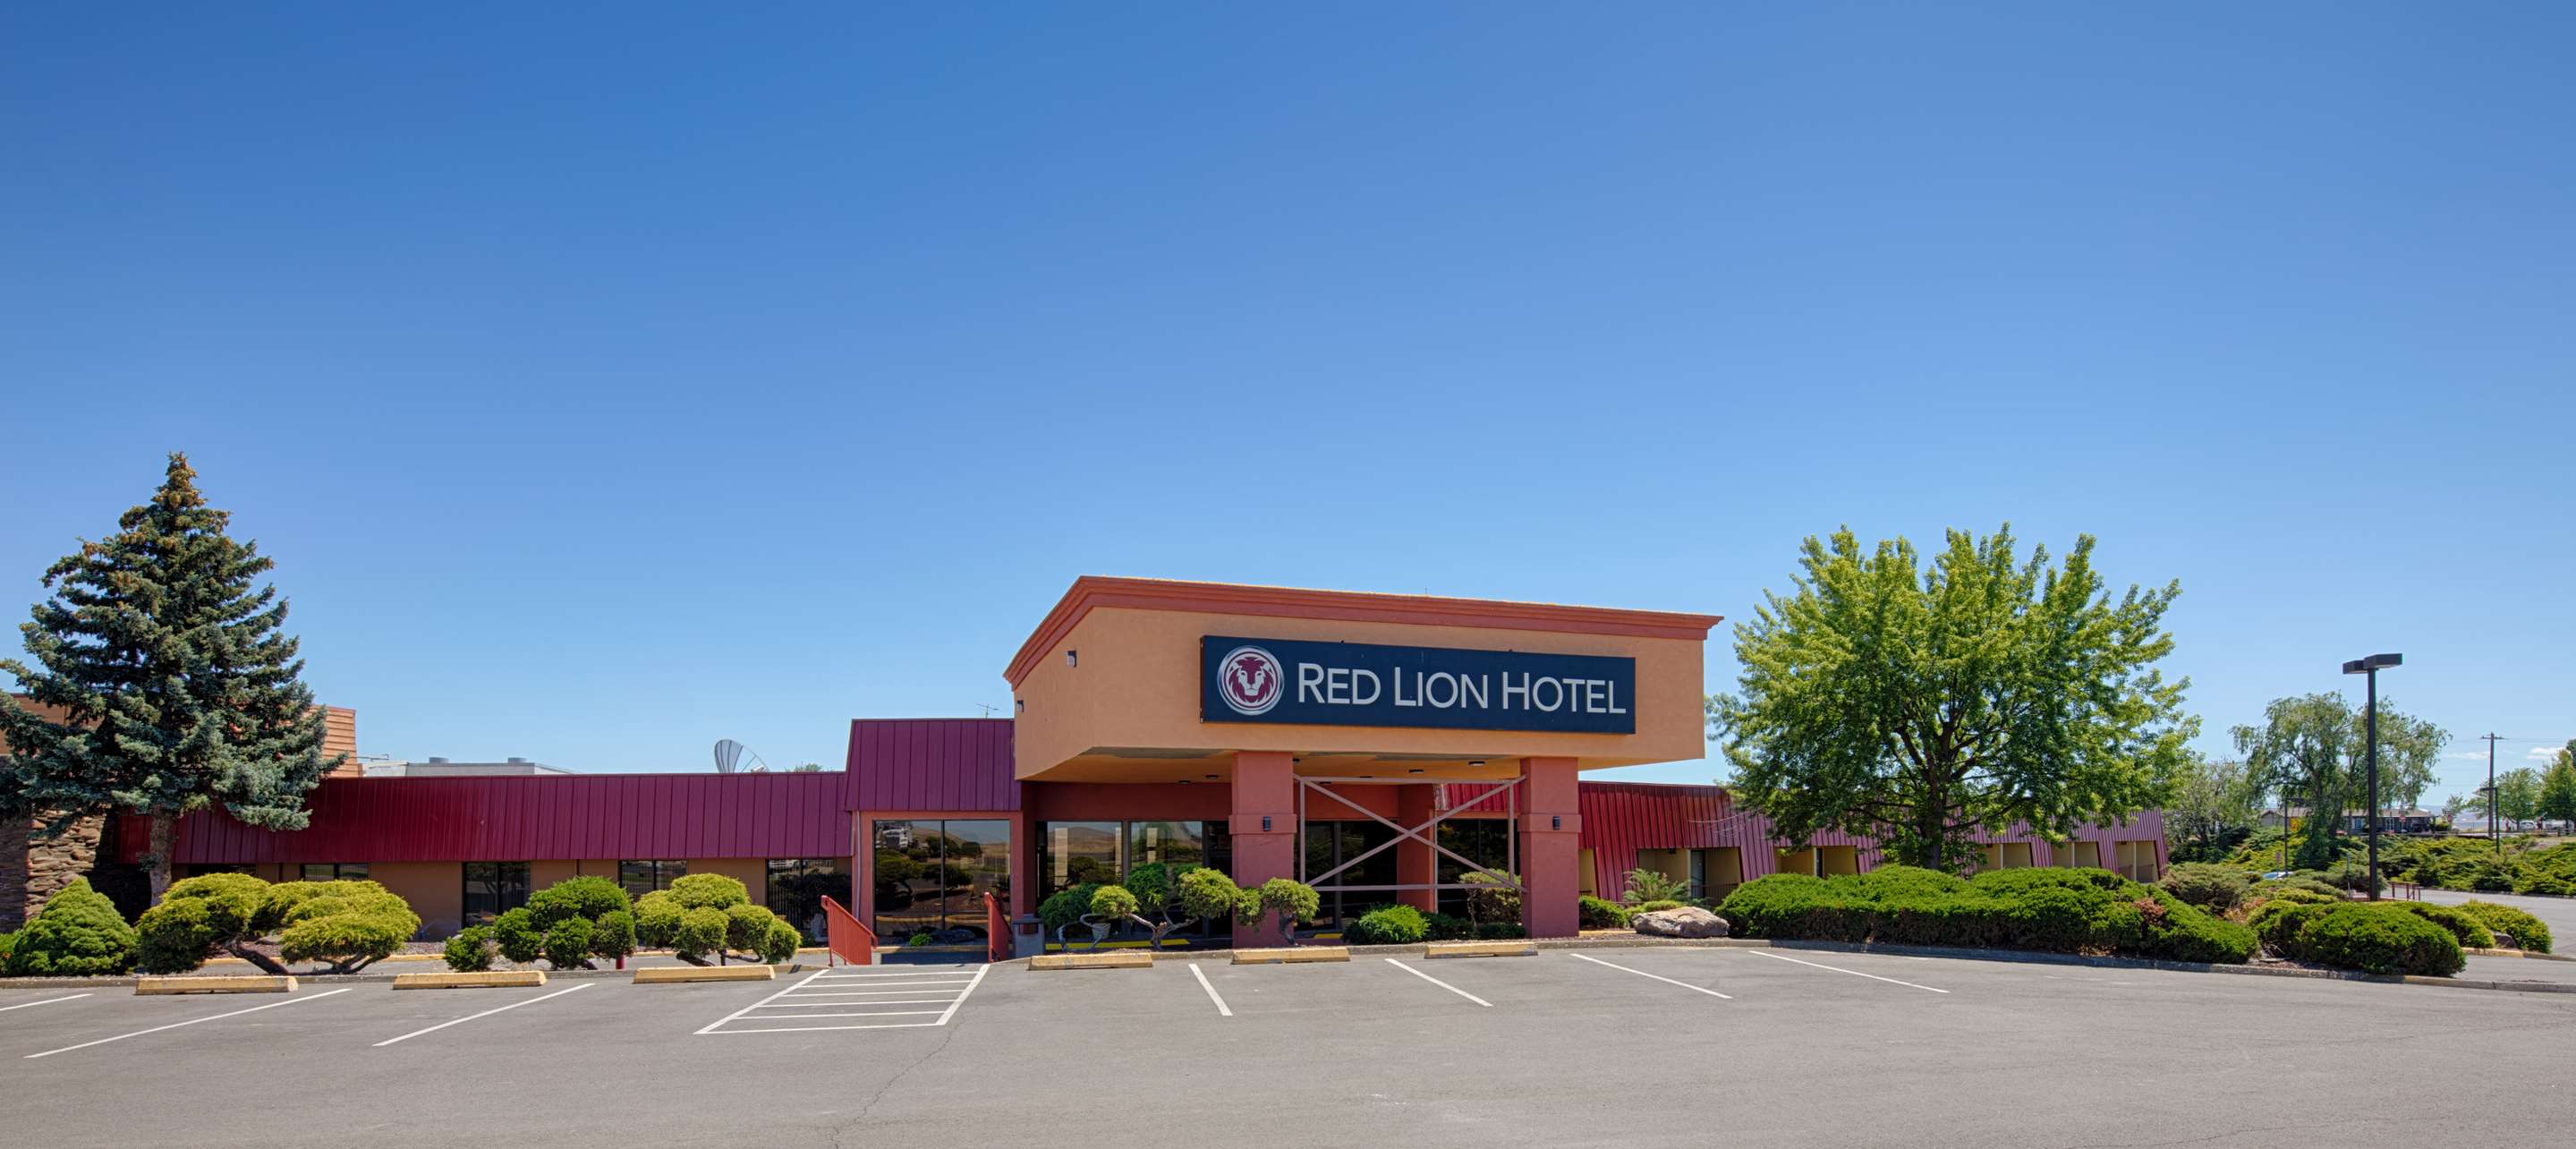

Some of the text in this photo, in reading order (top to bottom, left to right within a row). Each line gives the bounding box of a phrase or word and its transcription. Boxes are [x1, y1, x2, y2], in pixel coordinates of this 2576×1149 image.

[1298, 663, 1627, 714] RED LION HOTEL
